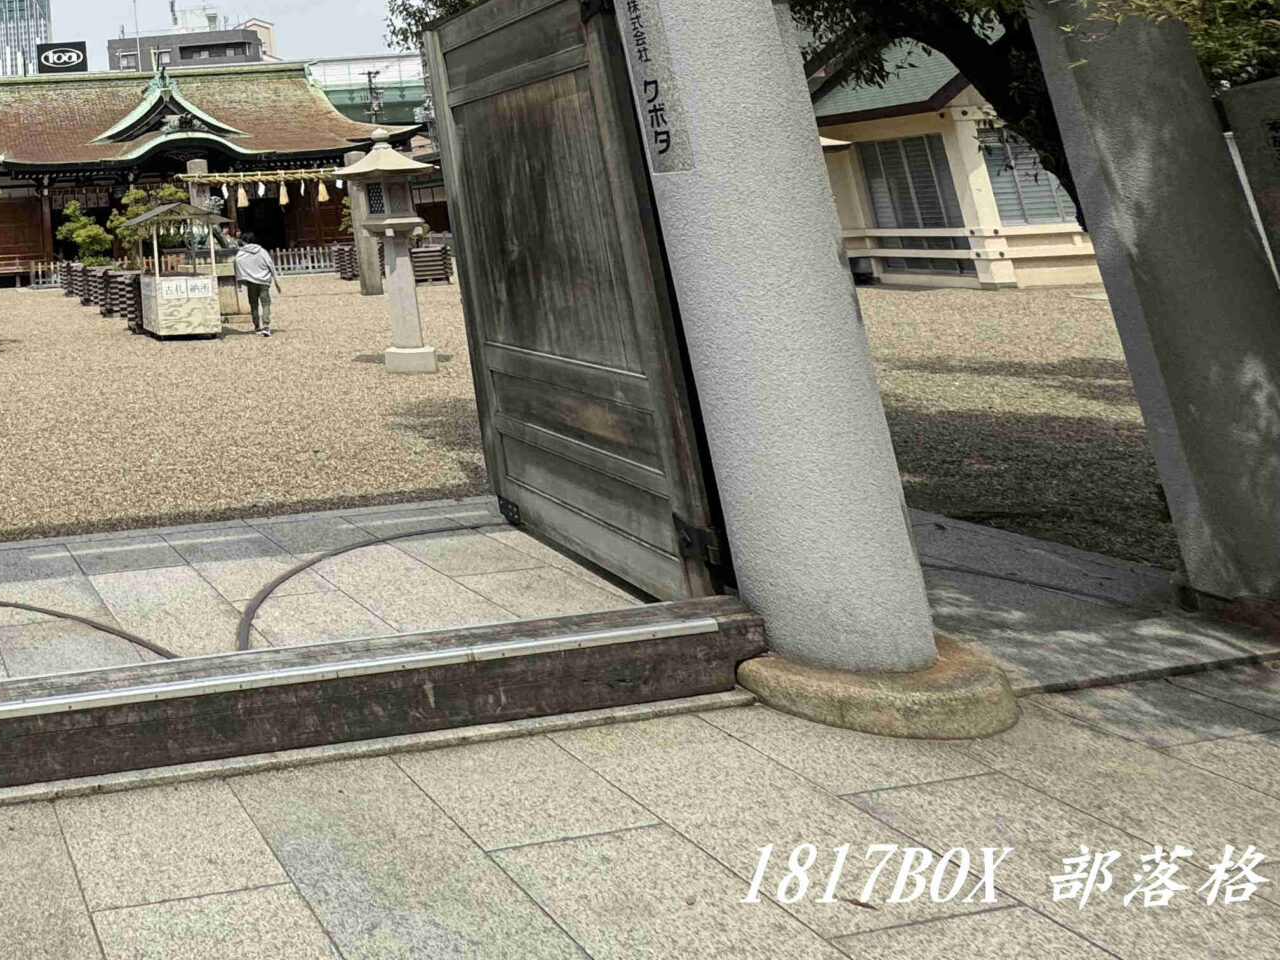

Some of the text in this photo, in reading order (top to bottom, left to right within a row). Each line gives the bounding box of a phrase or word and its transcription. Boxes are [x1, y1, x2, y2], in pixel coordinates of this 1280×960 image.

[46, 51, 78, 64] toa
[627, 0, 670, 154] 株式会社 クボタ
